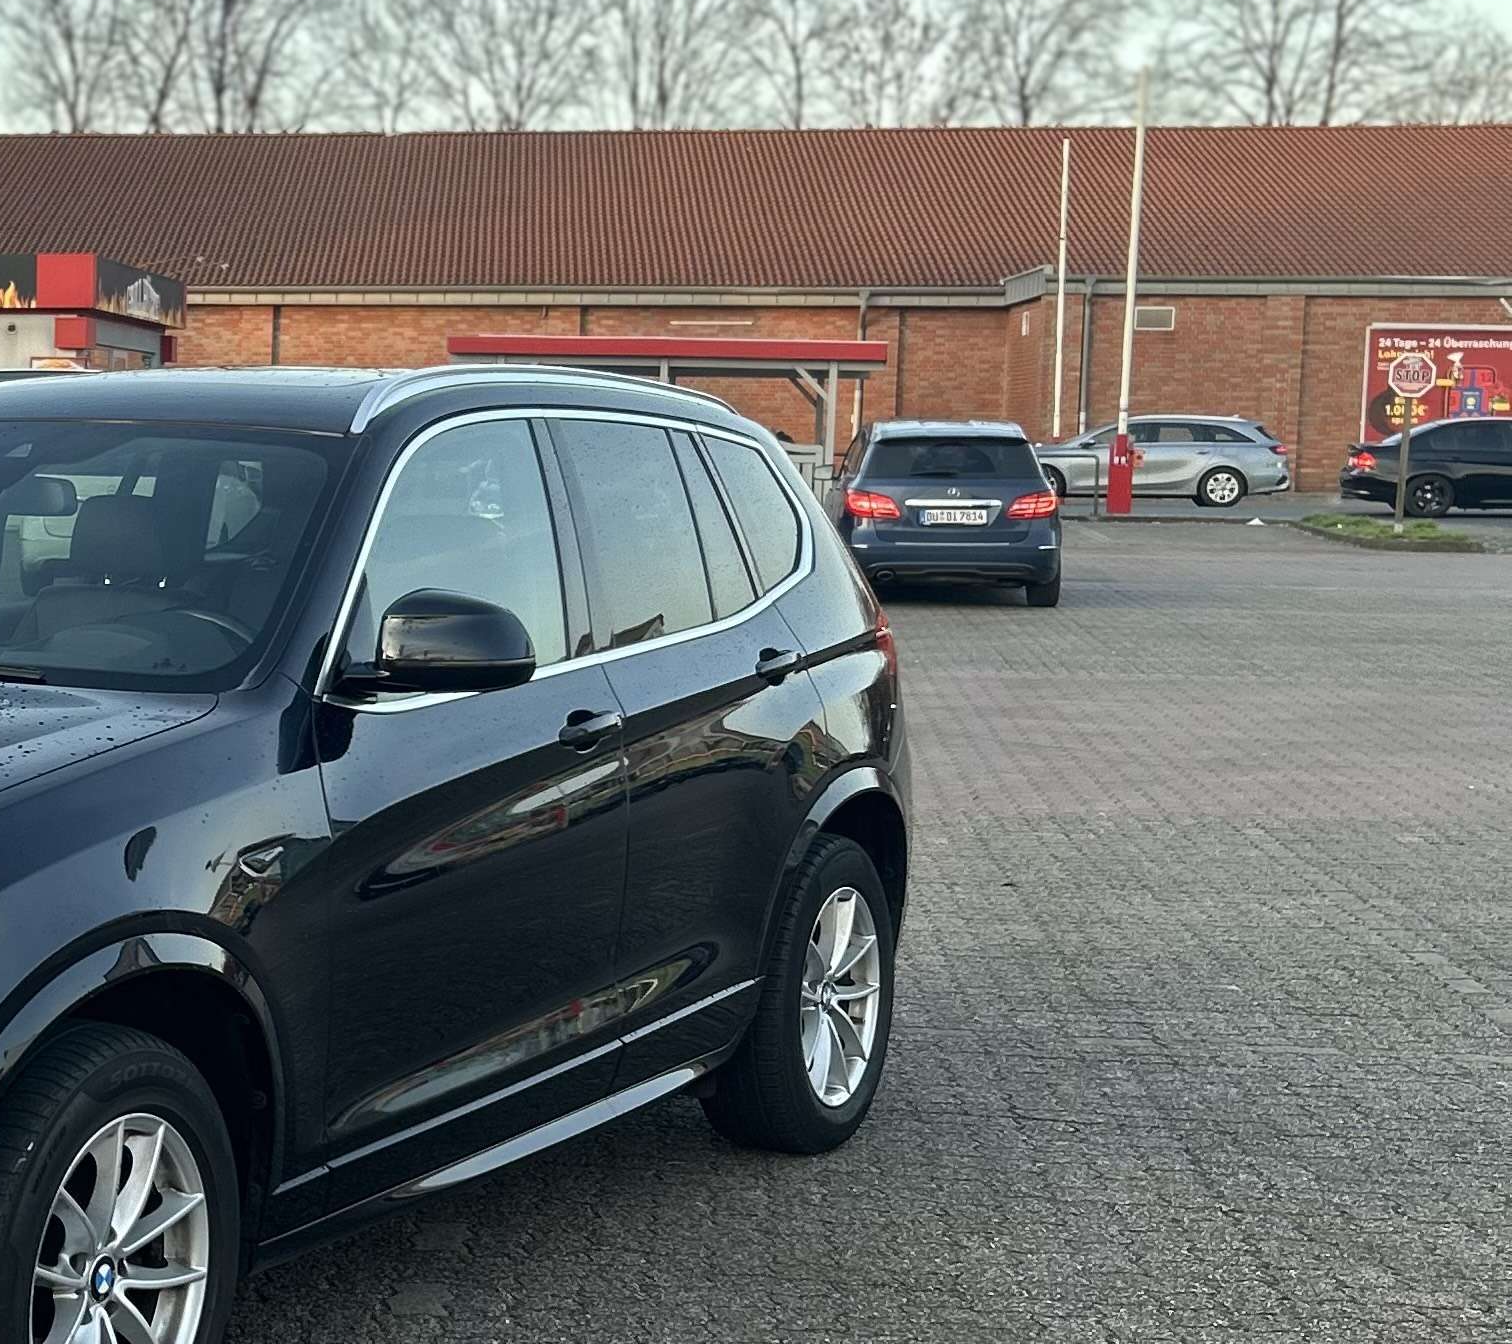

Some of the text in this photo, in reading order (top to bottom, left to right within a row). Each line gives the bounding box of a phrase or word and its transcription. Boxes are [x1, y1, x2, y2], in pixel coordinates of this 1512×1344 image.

[1379, 337, 1391, 348] 24
[1393, 338, 1418, 349] Tage
[1428, 338, 1441, 348] 24
[1396, 369, 1431, 381] STOP
